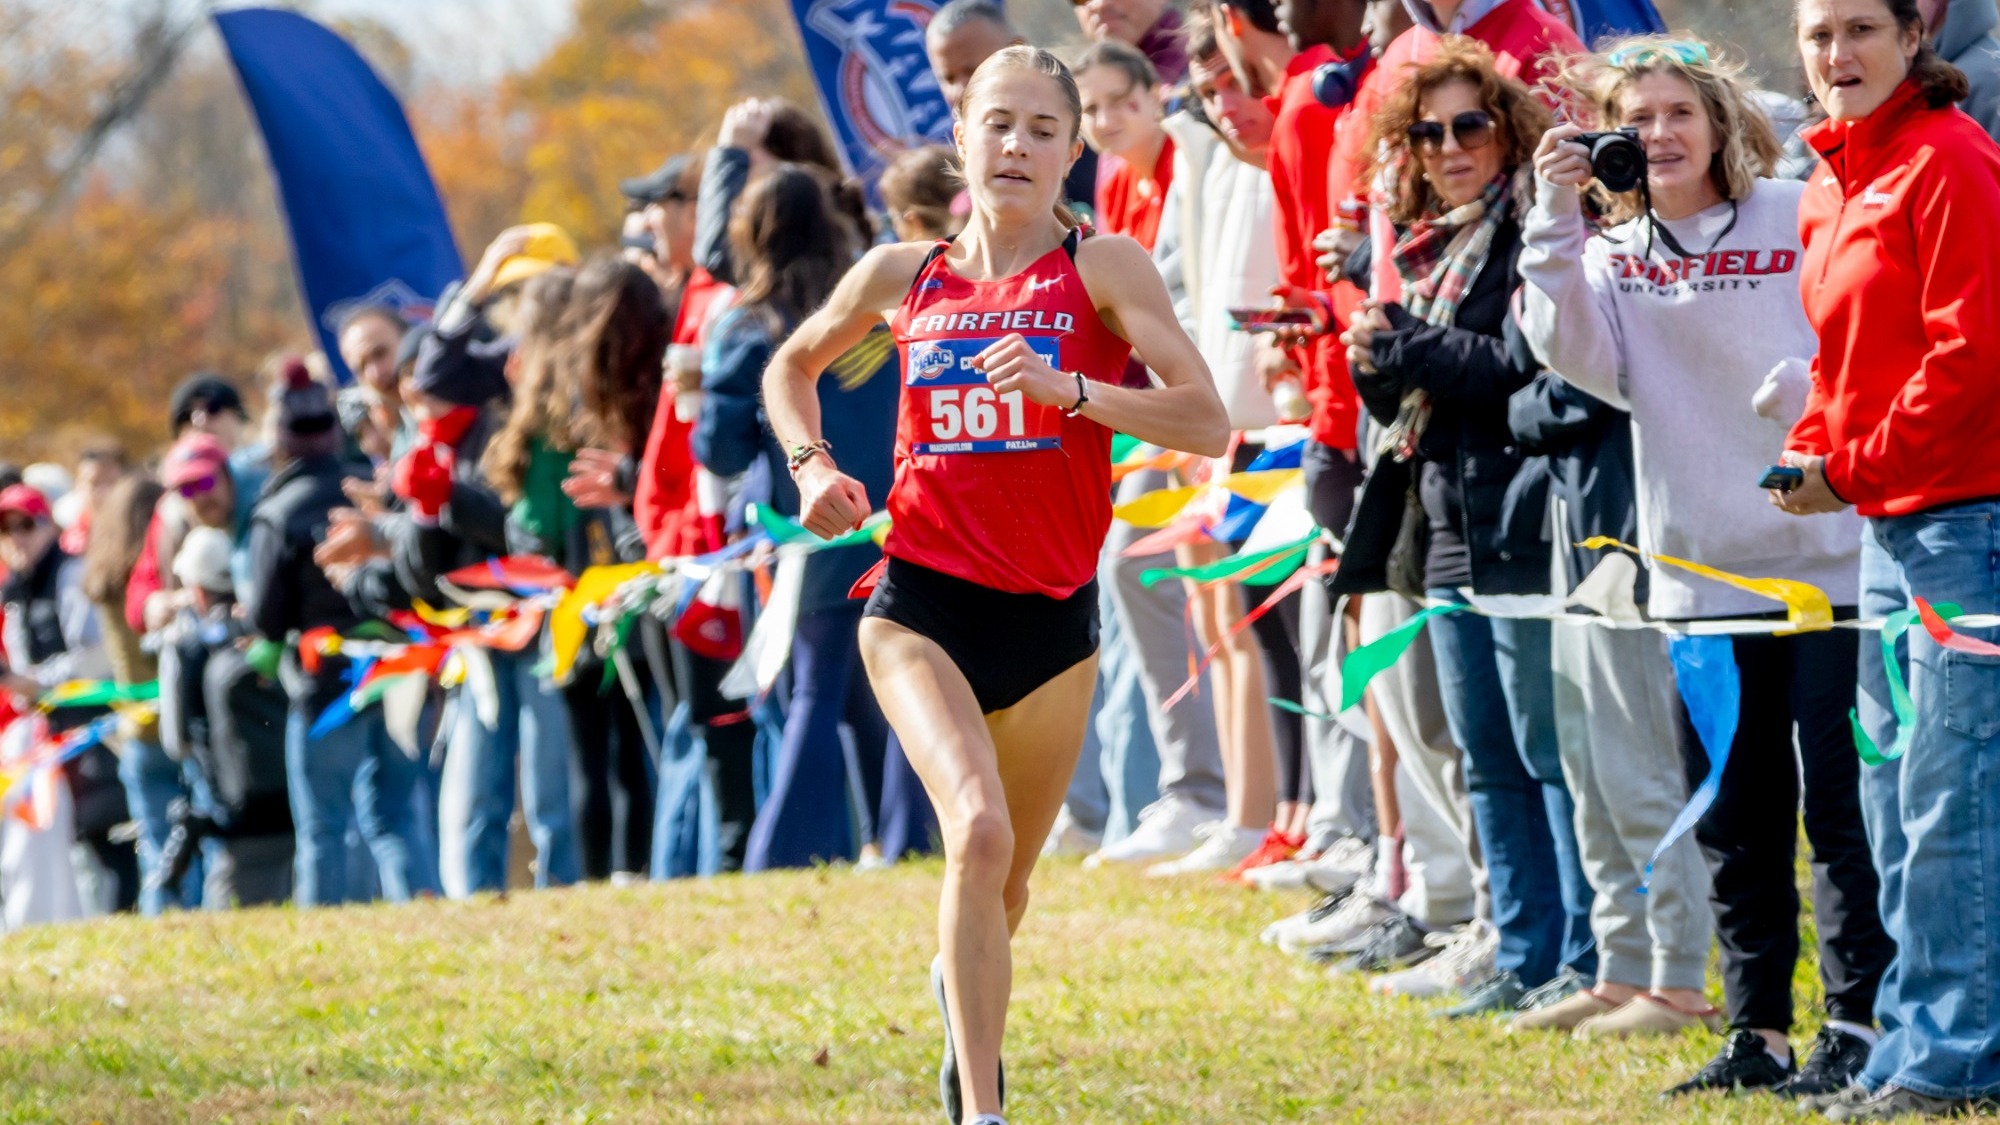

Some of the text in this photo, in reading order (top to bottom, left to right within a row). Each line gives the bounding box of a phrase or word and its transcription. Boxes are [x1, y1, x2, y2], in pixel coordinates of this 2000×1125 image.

[1607, 249, 1797, 287] FAIRFIELD
[1619, 278, 1762, 297] UNIVERSITY
[908, 311, 1074, 336] FAIRFIELD
[930, 386, 1025, 440] 561
